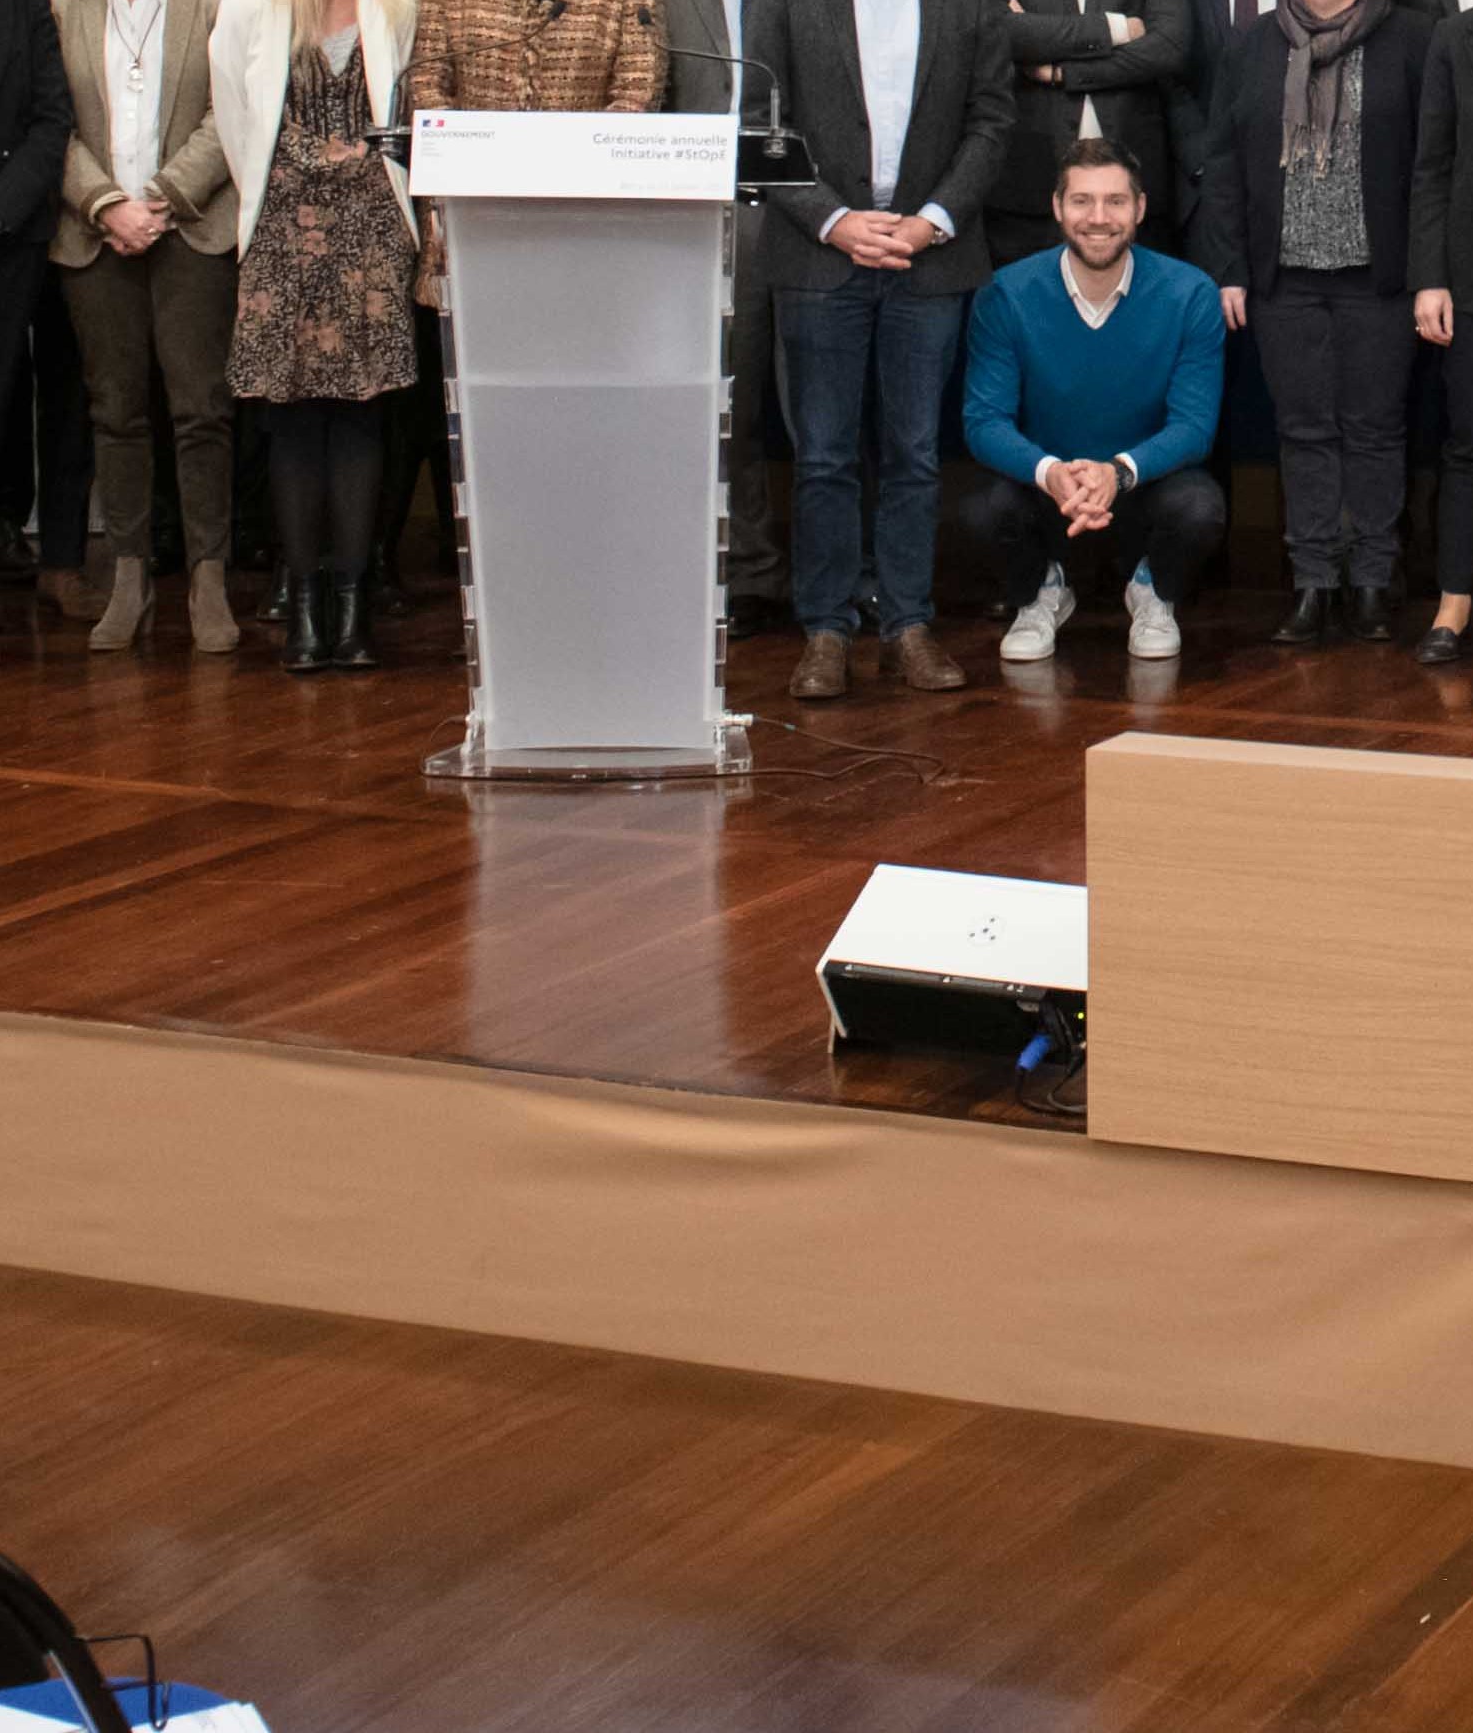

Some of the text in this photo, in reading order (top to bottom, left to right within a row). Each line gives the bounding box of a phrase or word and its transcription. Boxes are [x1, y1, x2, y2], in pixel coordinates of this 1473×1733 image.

[421, 130, 495, 140] GOUVERNEMENT
[592, 132, 728, 147] Cérémonie annuelle
[611, 148, 727, 162] Initiative #StOpE
